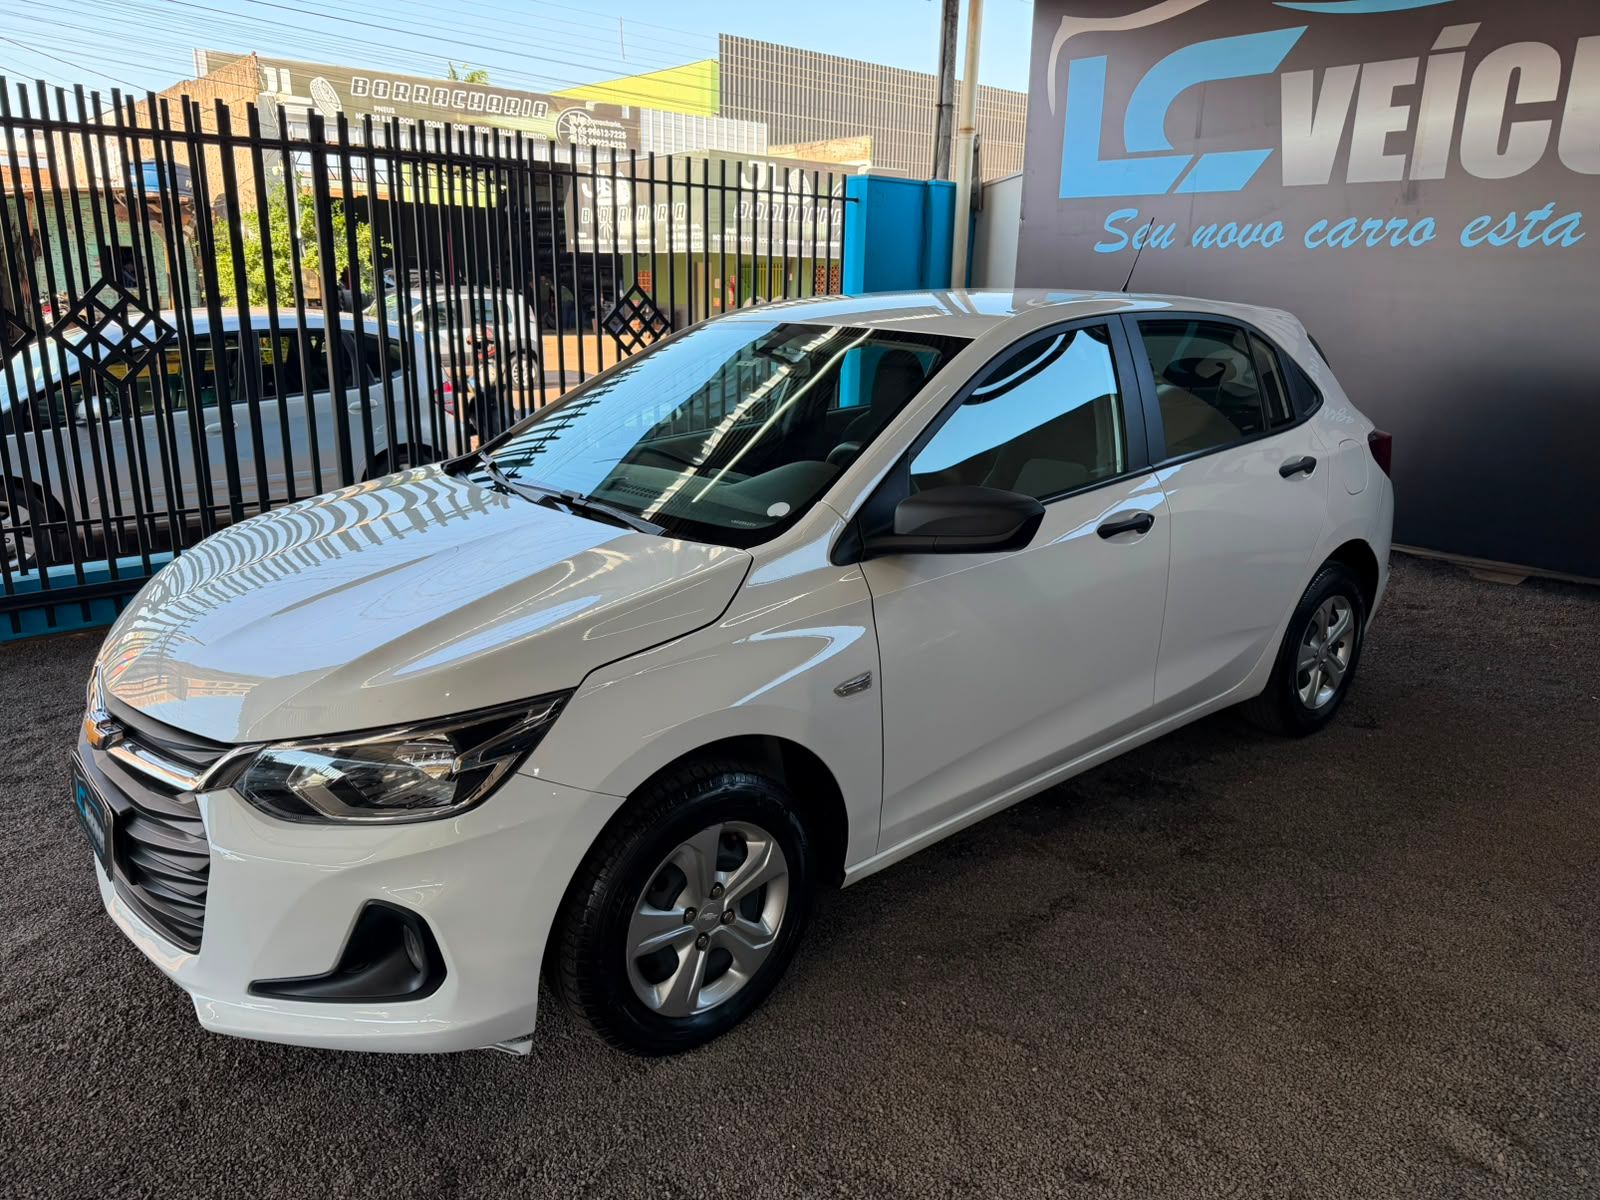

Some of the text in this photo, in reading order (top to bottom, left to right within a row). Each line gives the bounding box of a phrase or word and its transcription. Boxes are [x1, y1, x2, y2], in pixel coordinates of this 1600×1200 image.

[351, 76, 548, 119] BORRACHARIA
[373, 105, 395, 114] PNEUS
[1059, 25, 1309, 199] LC
[1094, 202, 1586, 253] Seu novo carro esta
